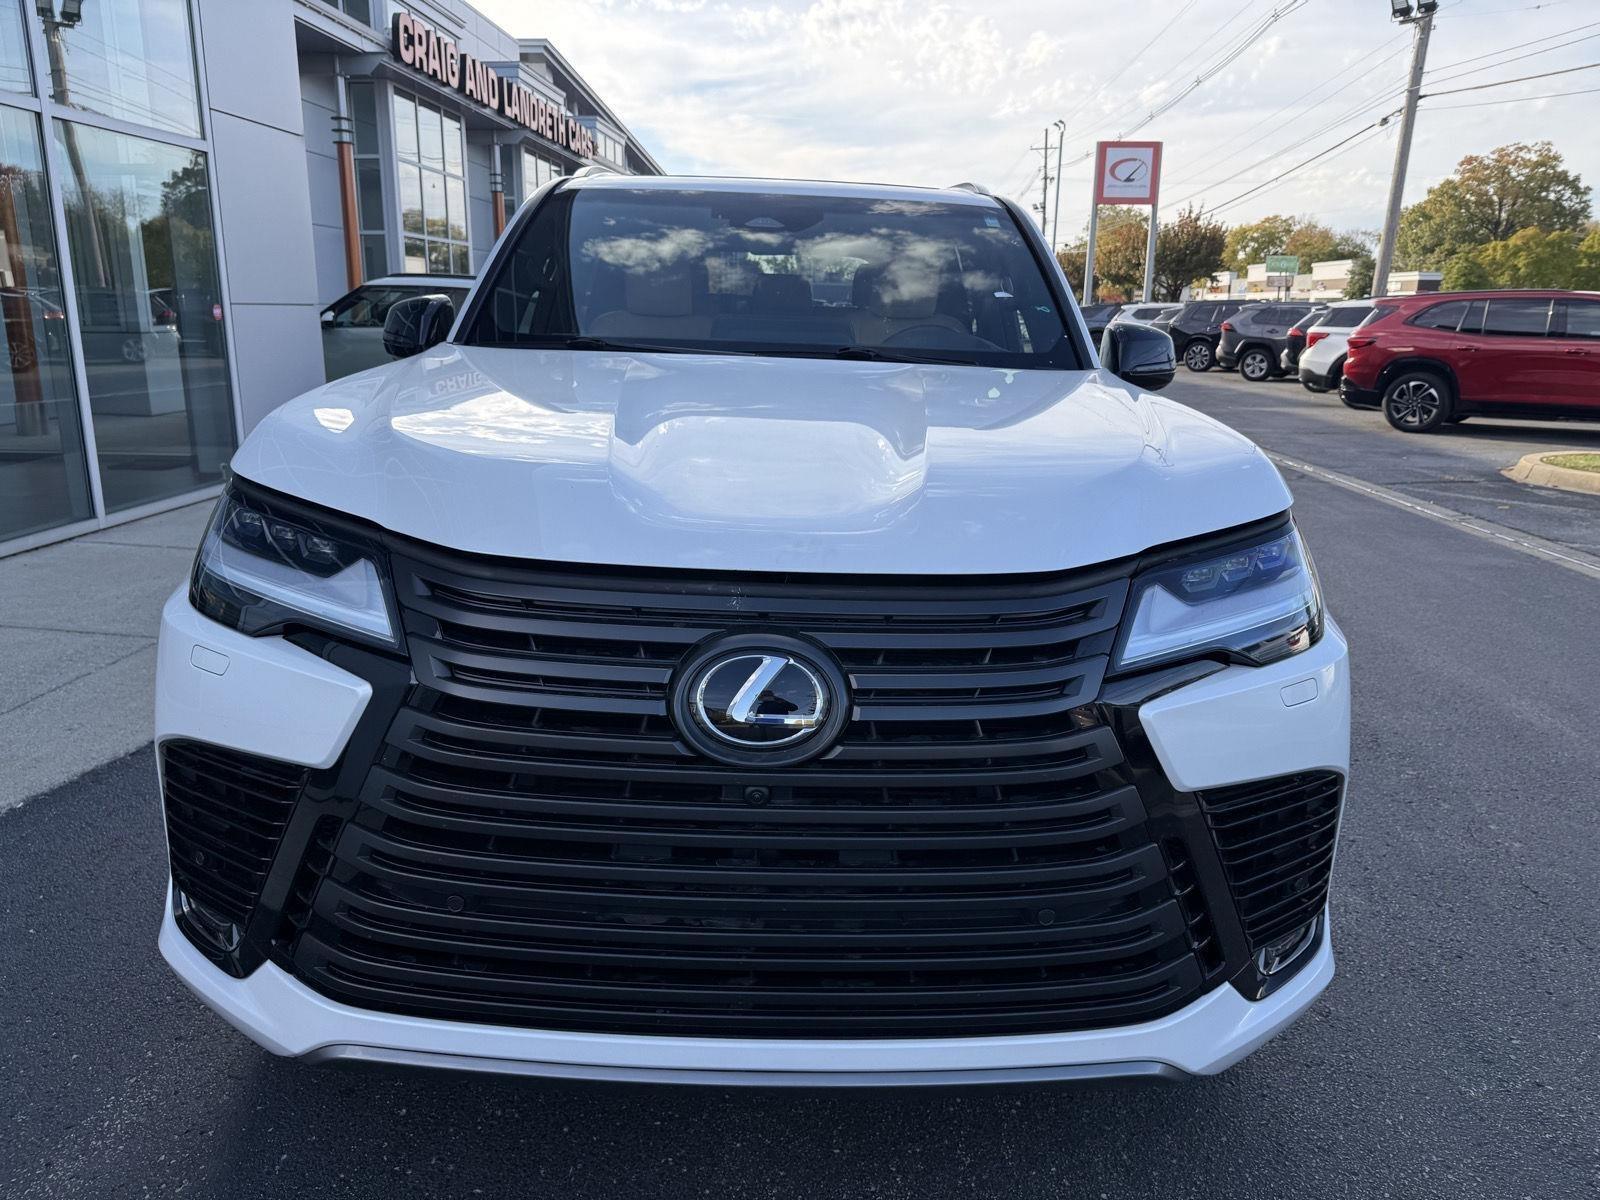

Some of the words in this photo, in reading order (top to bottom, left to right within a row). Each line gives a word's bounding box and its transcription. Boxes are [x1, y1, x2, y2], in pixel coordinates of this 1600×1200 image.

[394, 12, 460, 89] CRAIG
[461, 53, 499, 110] AND
[503, 78, 567, 147] LANDRETH
[568, 119, 593, 160] CARS
